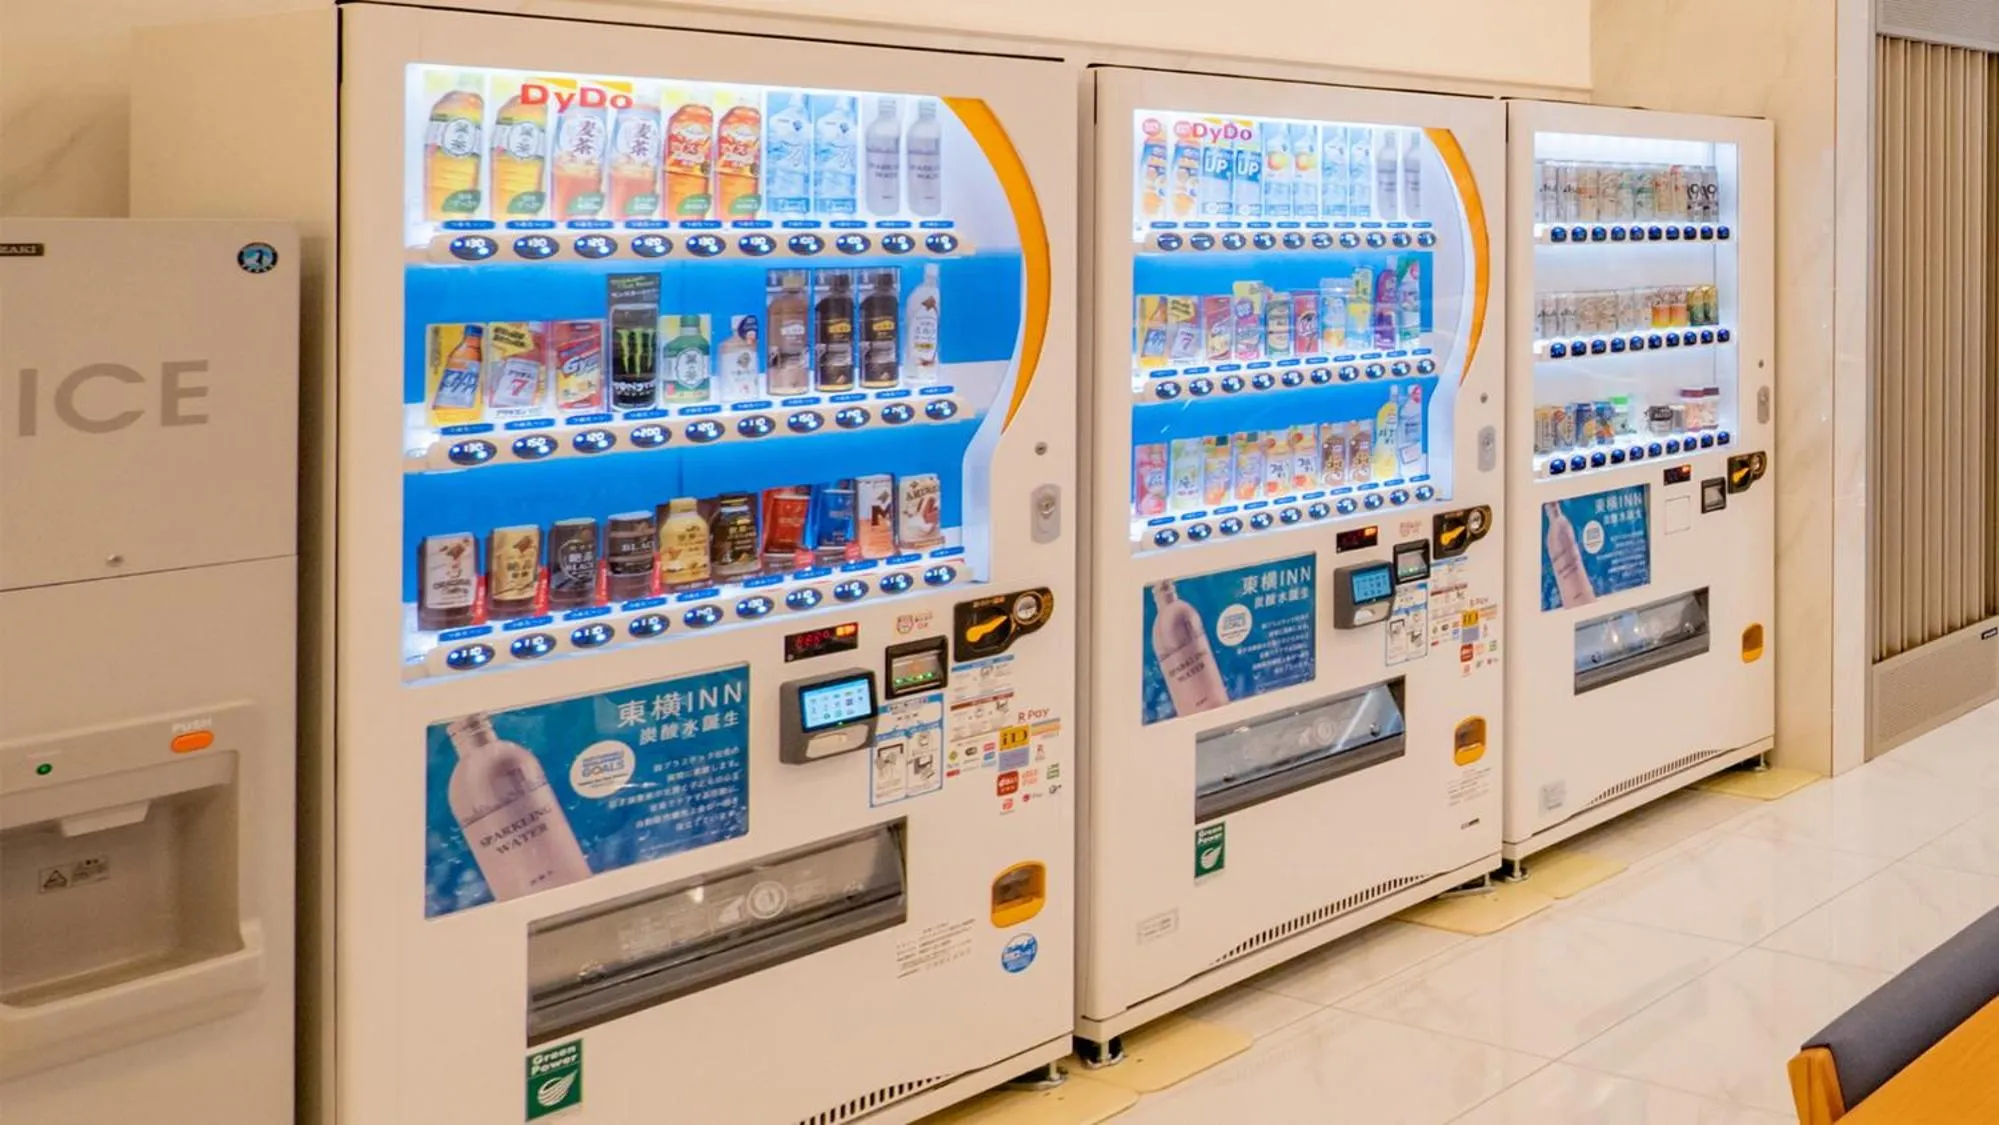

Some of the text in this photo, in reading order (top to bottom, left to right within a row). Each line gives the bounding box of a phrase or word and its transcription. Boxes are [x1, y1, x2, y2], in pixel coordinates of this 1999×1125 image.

[521, 84, 633, 113] DyDo
[1193, 123, 1252, 143] DyDo
[17, 359, 210, 437] ICE
[511, 379, 528, 396] 7
[1240, 566, 1312, 595] 東横INN
[617, 681, 742, 728] 東横INN
[172, 718, 212, 733] PUSH
[639, 710, 739, 746] 炭酸水誕生
[496, 822, 548, 854] WATER
[531, 1054, 578, 1076] Power
[532, 1045, 577, 1065] Green
